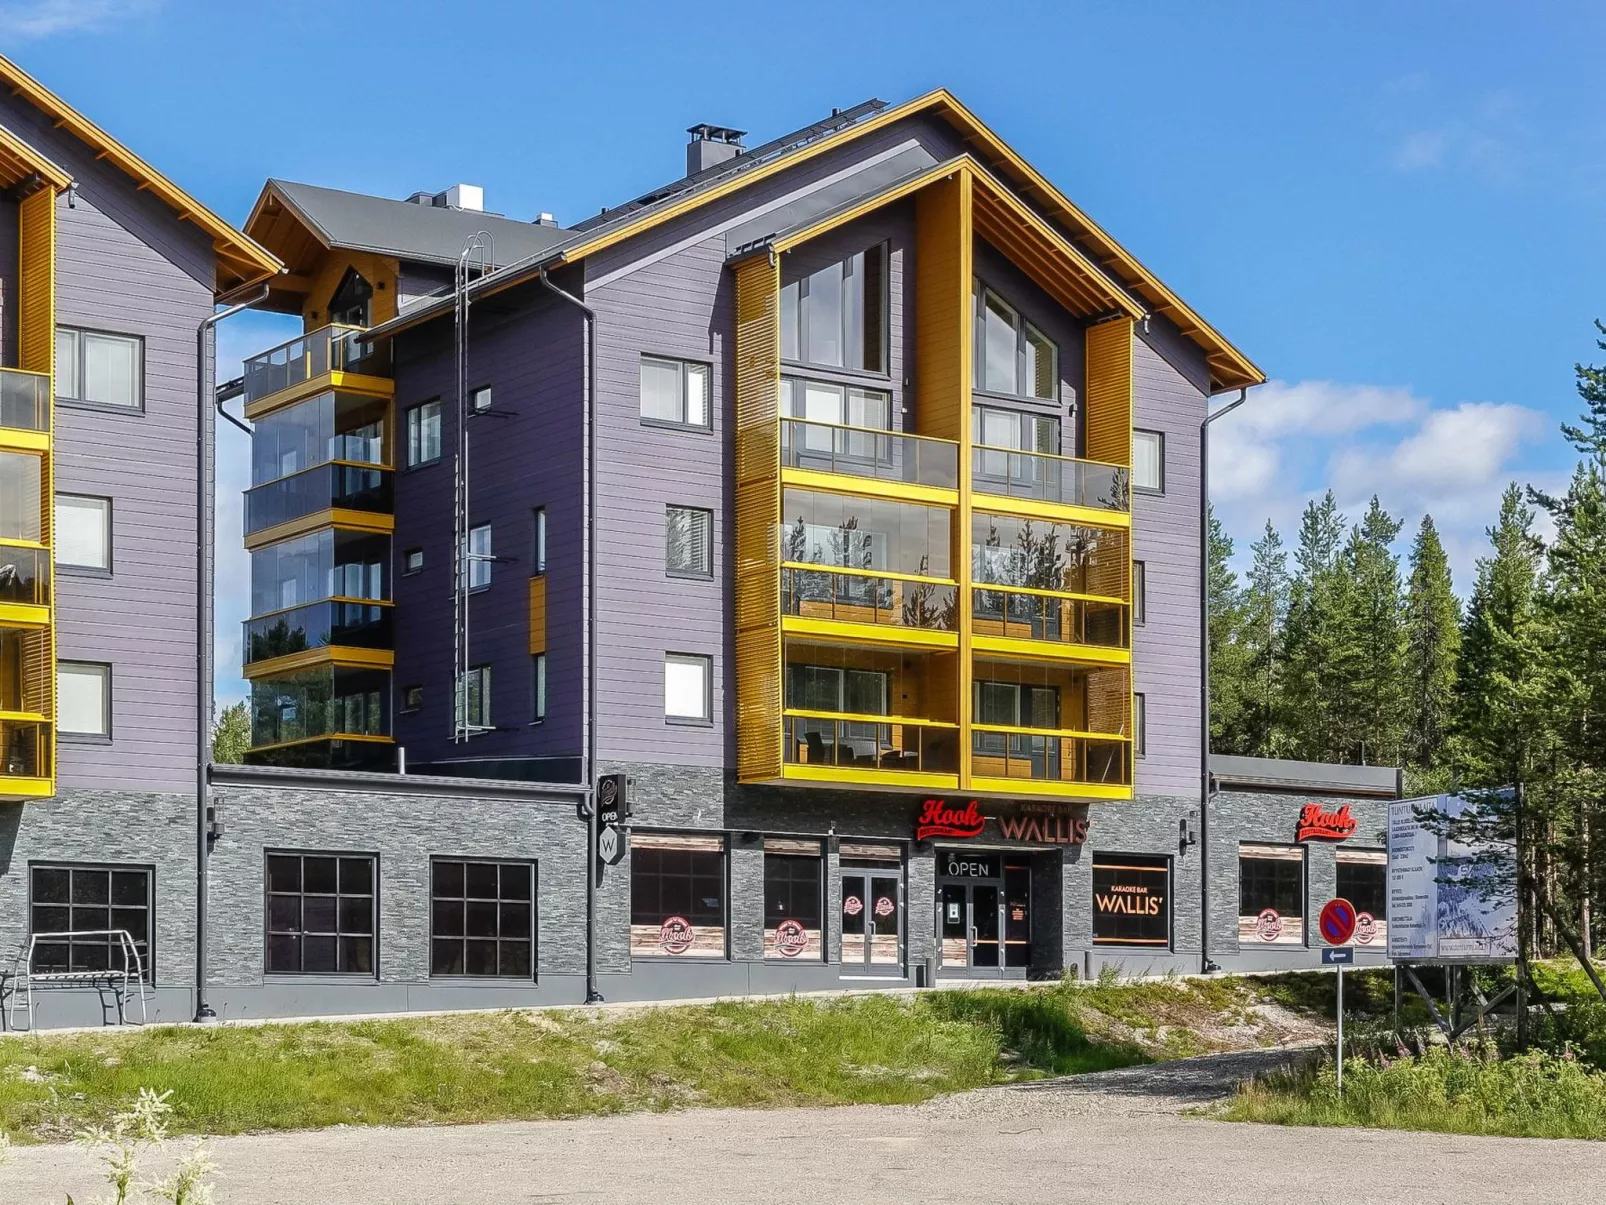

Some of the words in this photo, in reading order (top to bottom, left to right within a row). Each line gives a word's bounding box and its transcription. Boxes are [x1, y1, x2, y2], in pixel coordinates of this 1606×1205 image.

[919, 799, 983, 826] Hook
[1300, 803, 1354, 828] Hook
[602, 838, 615, 853] W
[948, 861, 989, 877] OPEN
[1111, 885, 1136, 893] KARAOKE
[1095, 893, 1163, 915] WALLIS'
